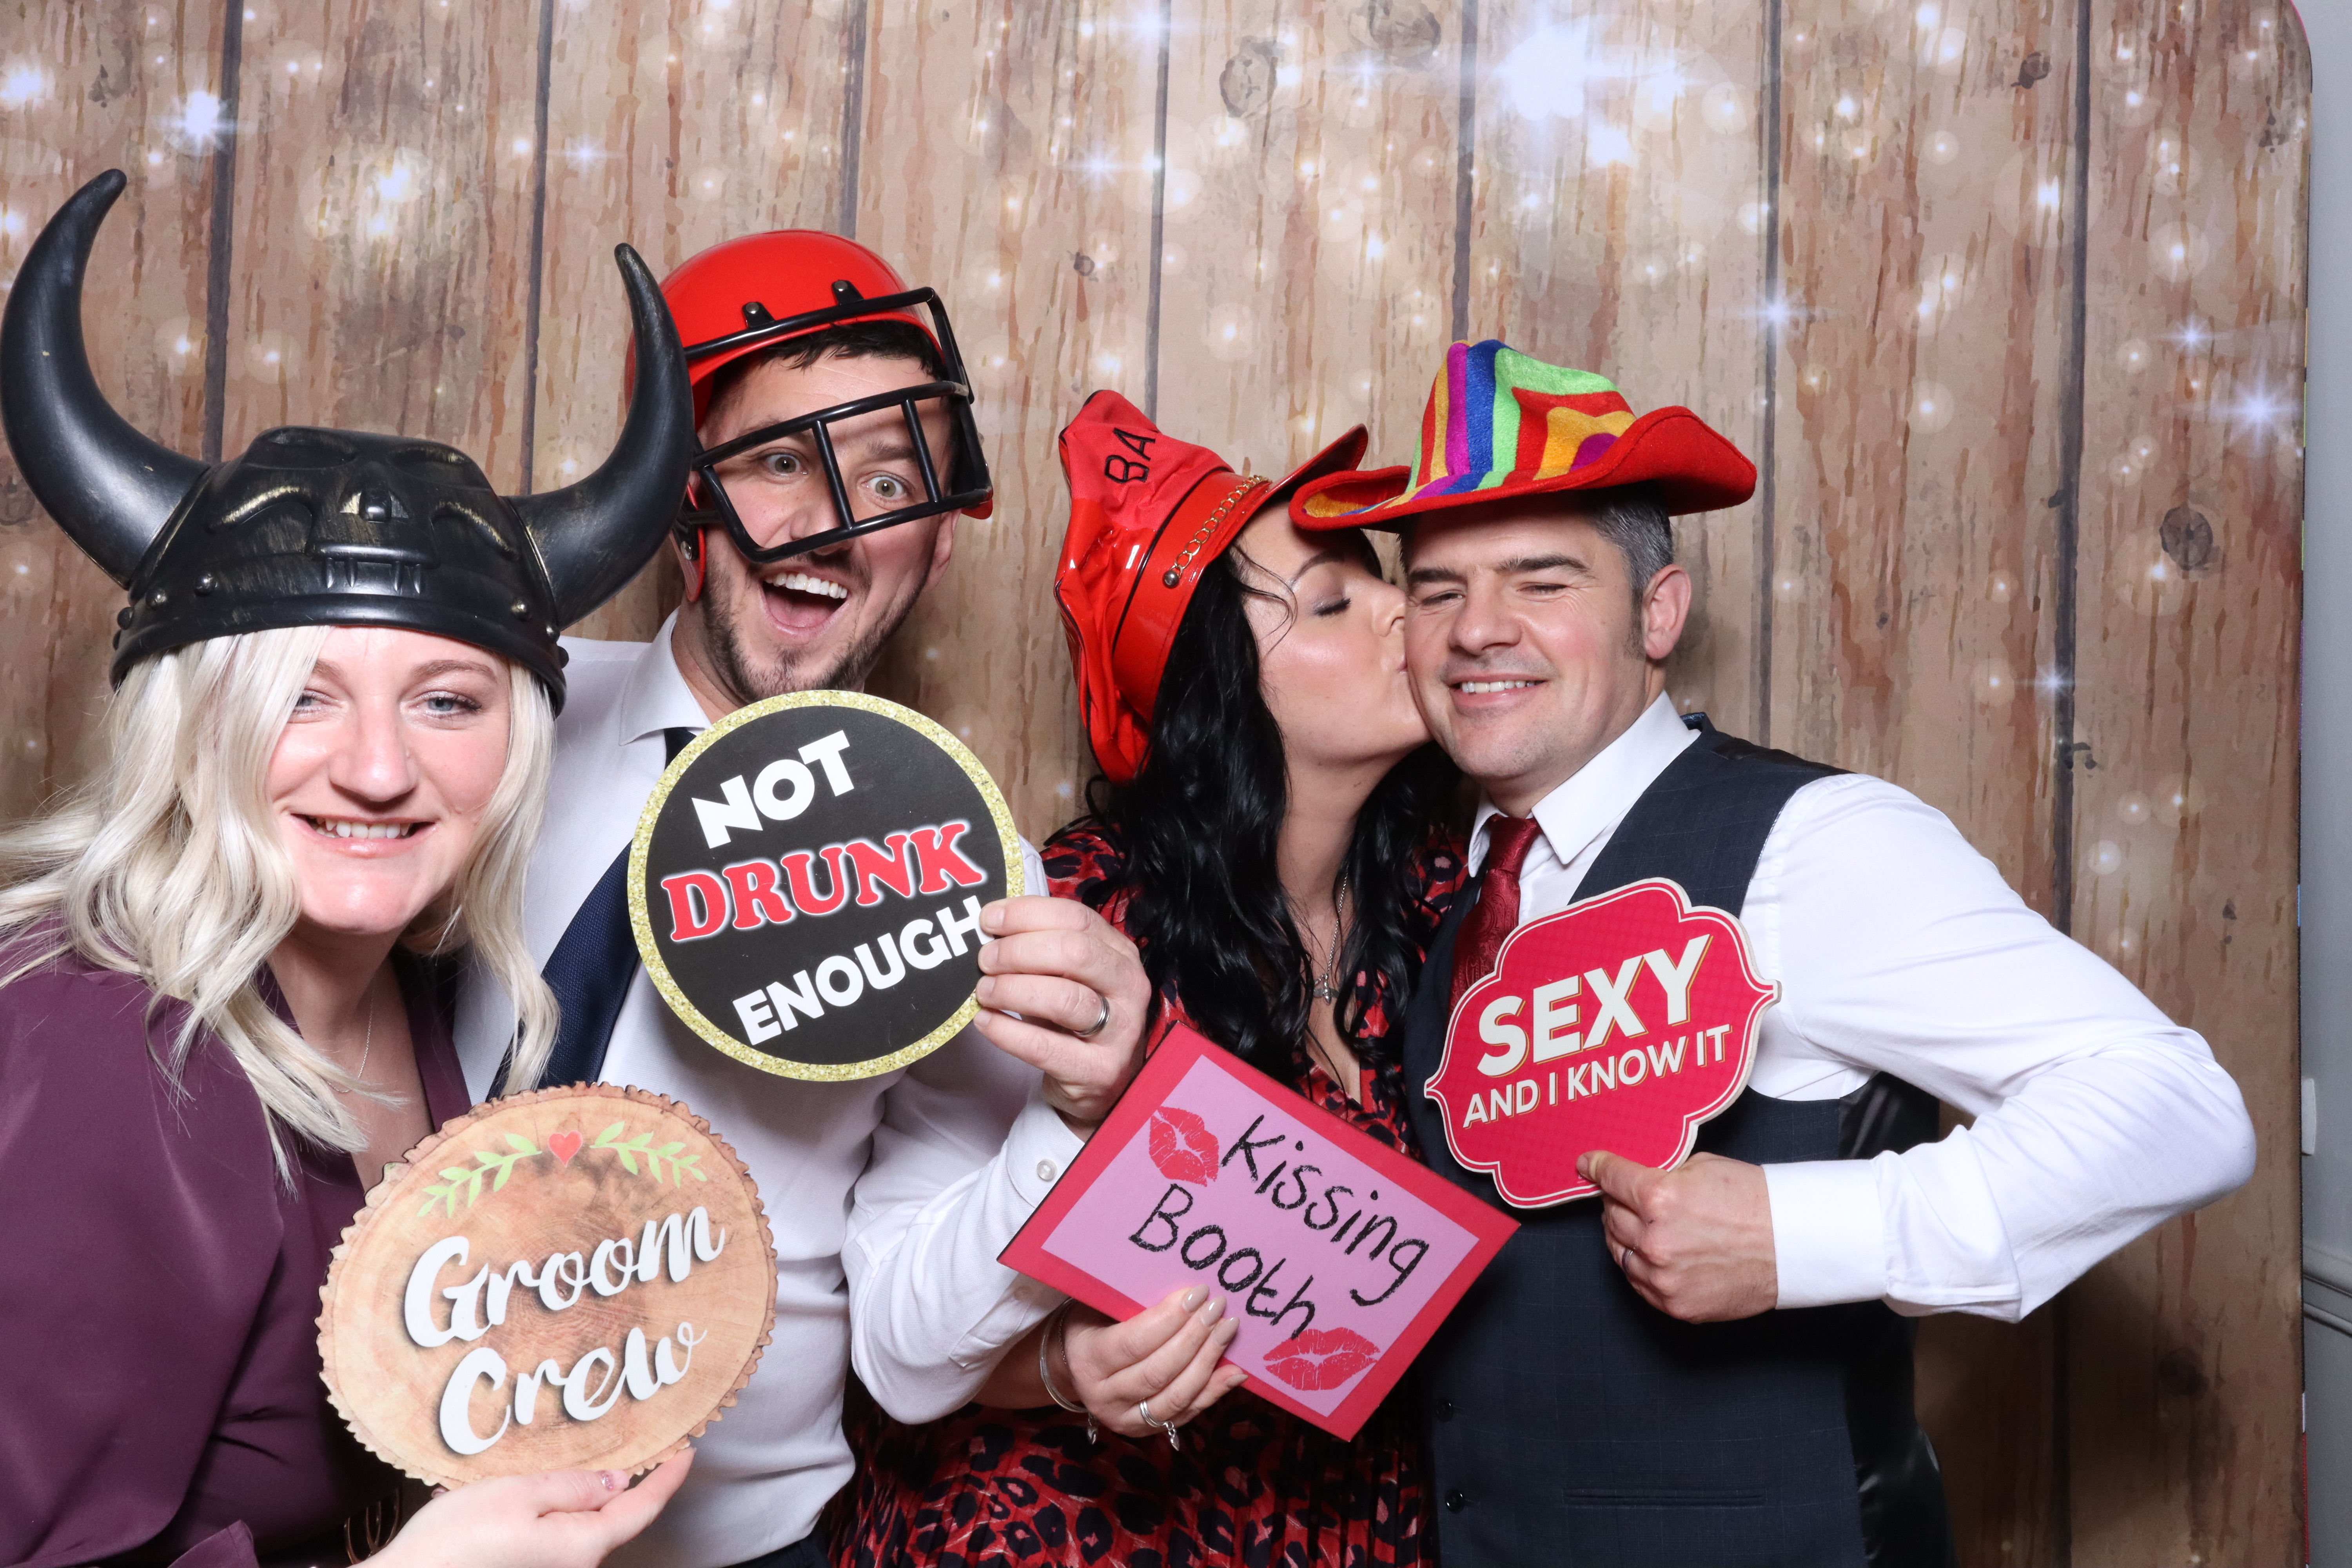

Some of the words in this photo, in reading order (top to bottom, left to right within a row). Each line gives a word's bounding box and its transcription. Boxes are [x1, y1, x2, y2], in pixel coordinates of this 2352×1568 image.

[691, 730, 854, 849] NOT
[661, 822, 989, 942] DRUNK
[732, 895, 995, 1046] ENOUGH
[1477, 934, 1713, 1076] SEXY
[1463, 1079, 1540, 1128] AND
[1549, 1072, 1558, 1105] I
[1568, 1036, 1689, 1101] KNOW
[1696, 1024, 1732, 1066] IT
[404, 1206, 725, 1348] Groom
[1128, 1183, 1315, 1339] Booth
[1220, 1114, 1429, 1307] Kissing
[439, 1321, 707, 1455] Crew
